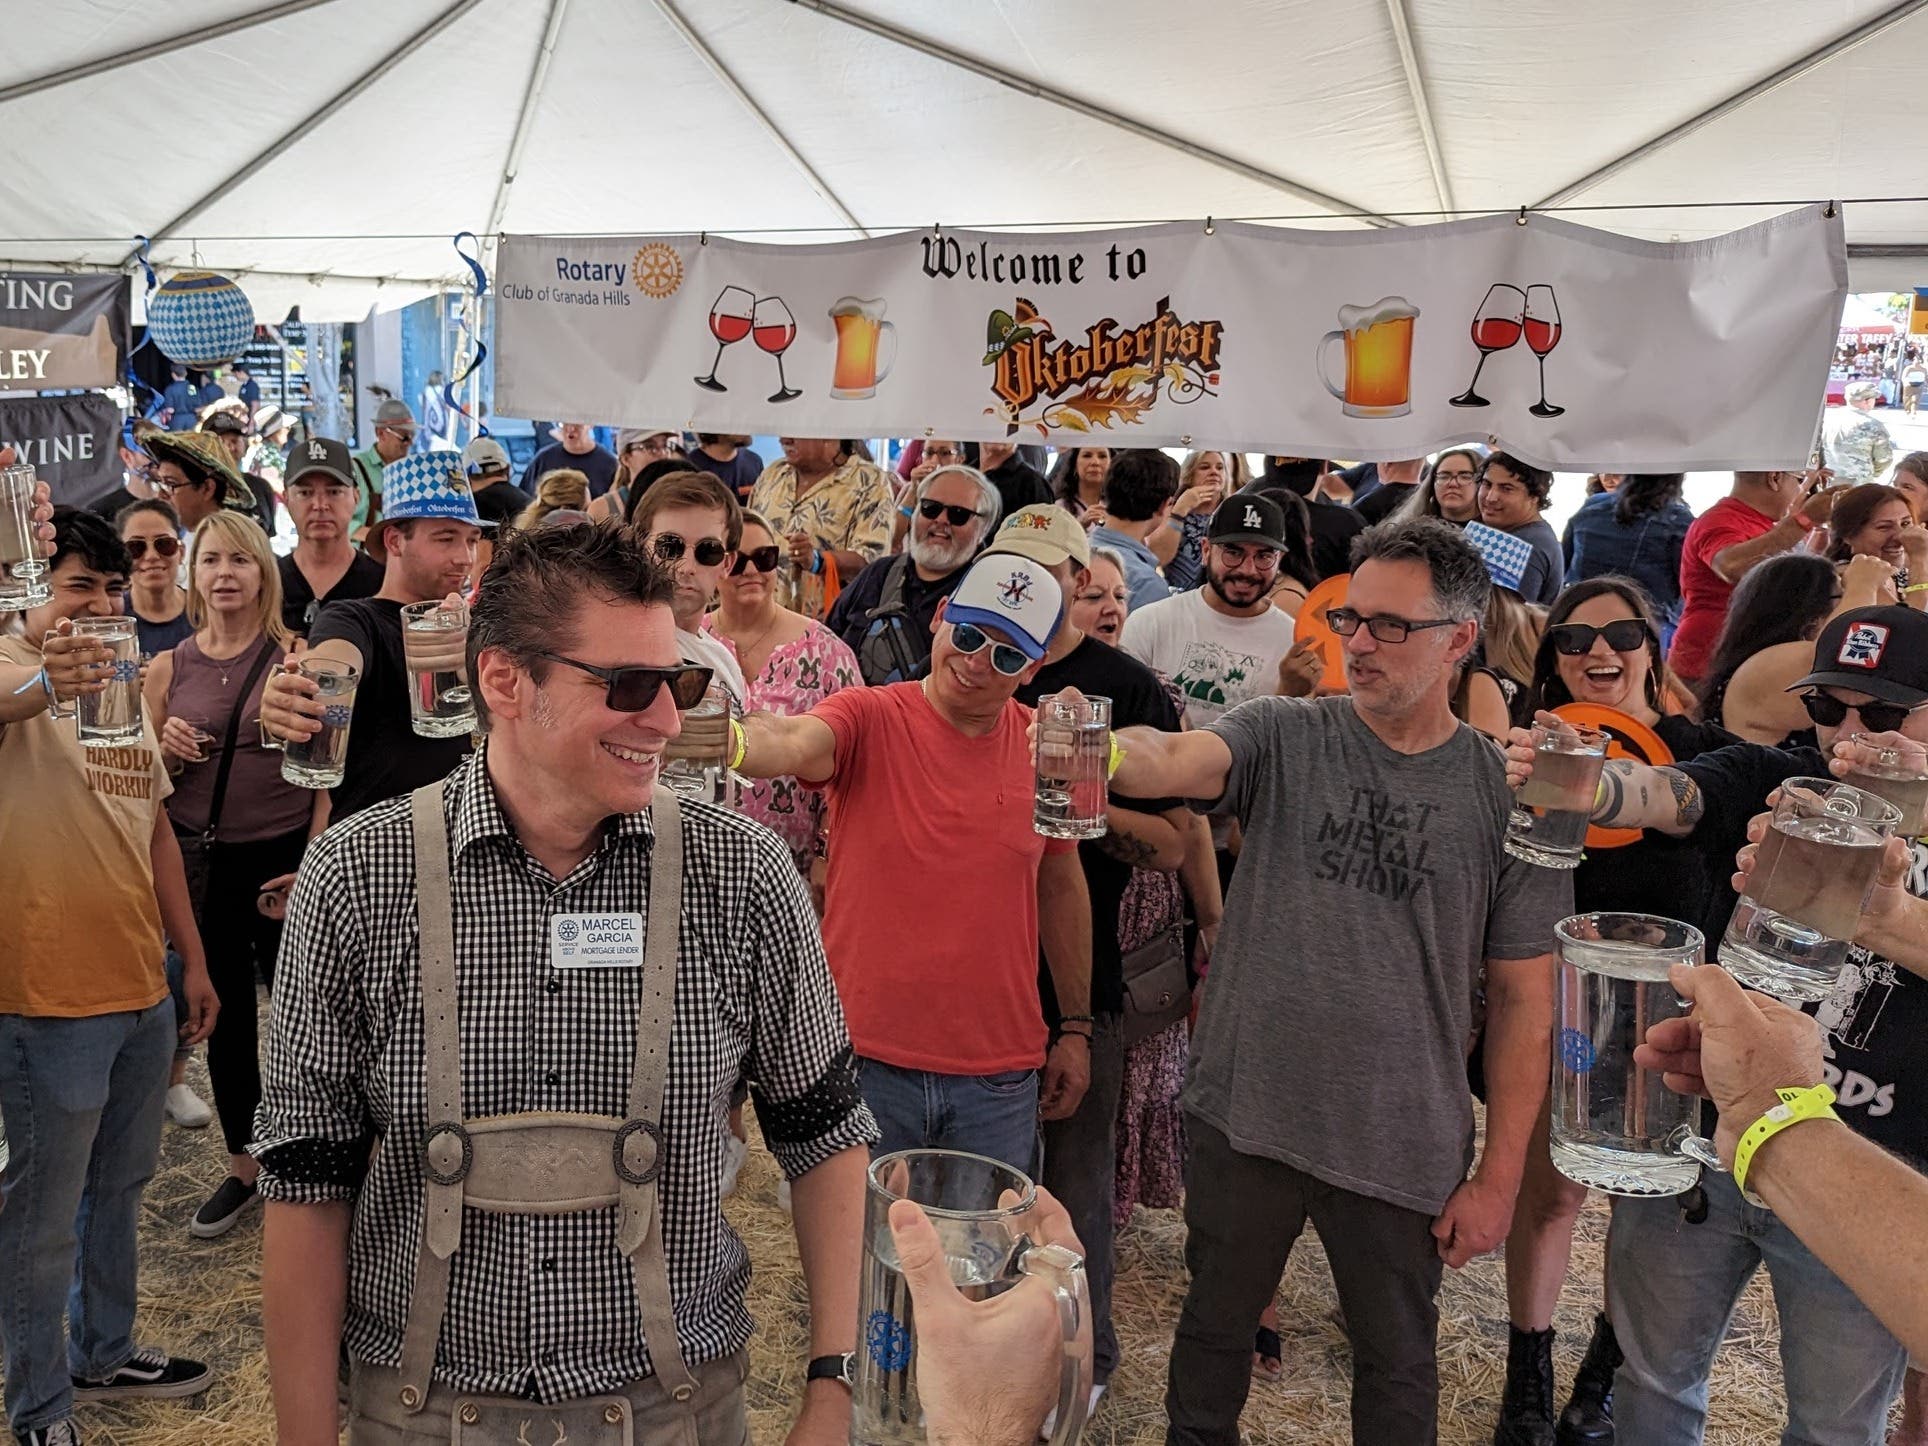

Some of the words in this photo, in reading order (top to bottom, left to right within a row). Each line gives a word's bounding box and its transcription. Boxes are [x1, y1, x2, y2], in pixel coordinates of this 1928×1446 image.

[556, 258, 626, 286] Rotary
[921, 237, 1084, 285] Welcome
[1106, 243, 1147, 281] to
[503, 284, 533, 301] Club
[537, 284, 550, 301] of
[552, 288, 600, 305] Granada
[603, 288, 631, 306] Hills
[990, 296, 1224, 425] Oktoberfest
[308, 440, 328, 460] LA
[1243, 504, 1262, 528] LA
[86, 746, 153, 771] HARDLY
[1349, 784, 1441, 833] THAT
[1317, 812, 1436, 876] METAL
[1314, 849, 1425, 907] SHOW
[582, 918, 637, 931] MARCEL
[587, 932, 633, 943] GARCIA
[581, 946, 616, 955] MORTGAGE
[616, 946, 640, 954] LENDER
